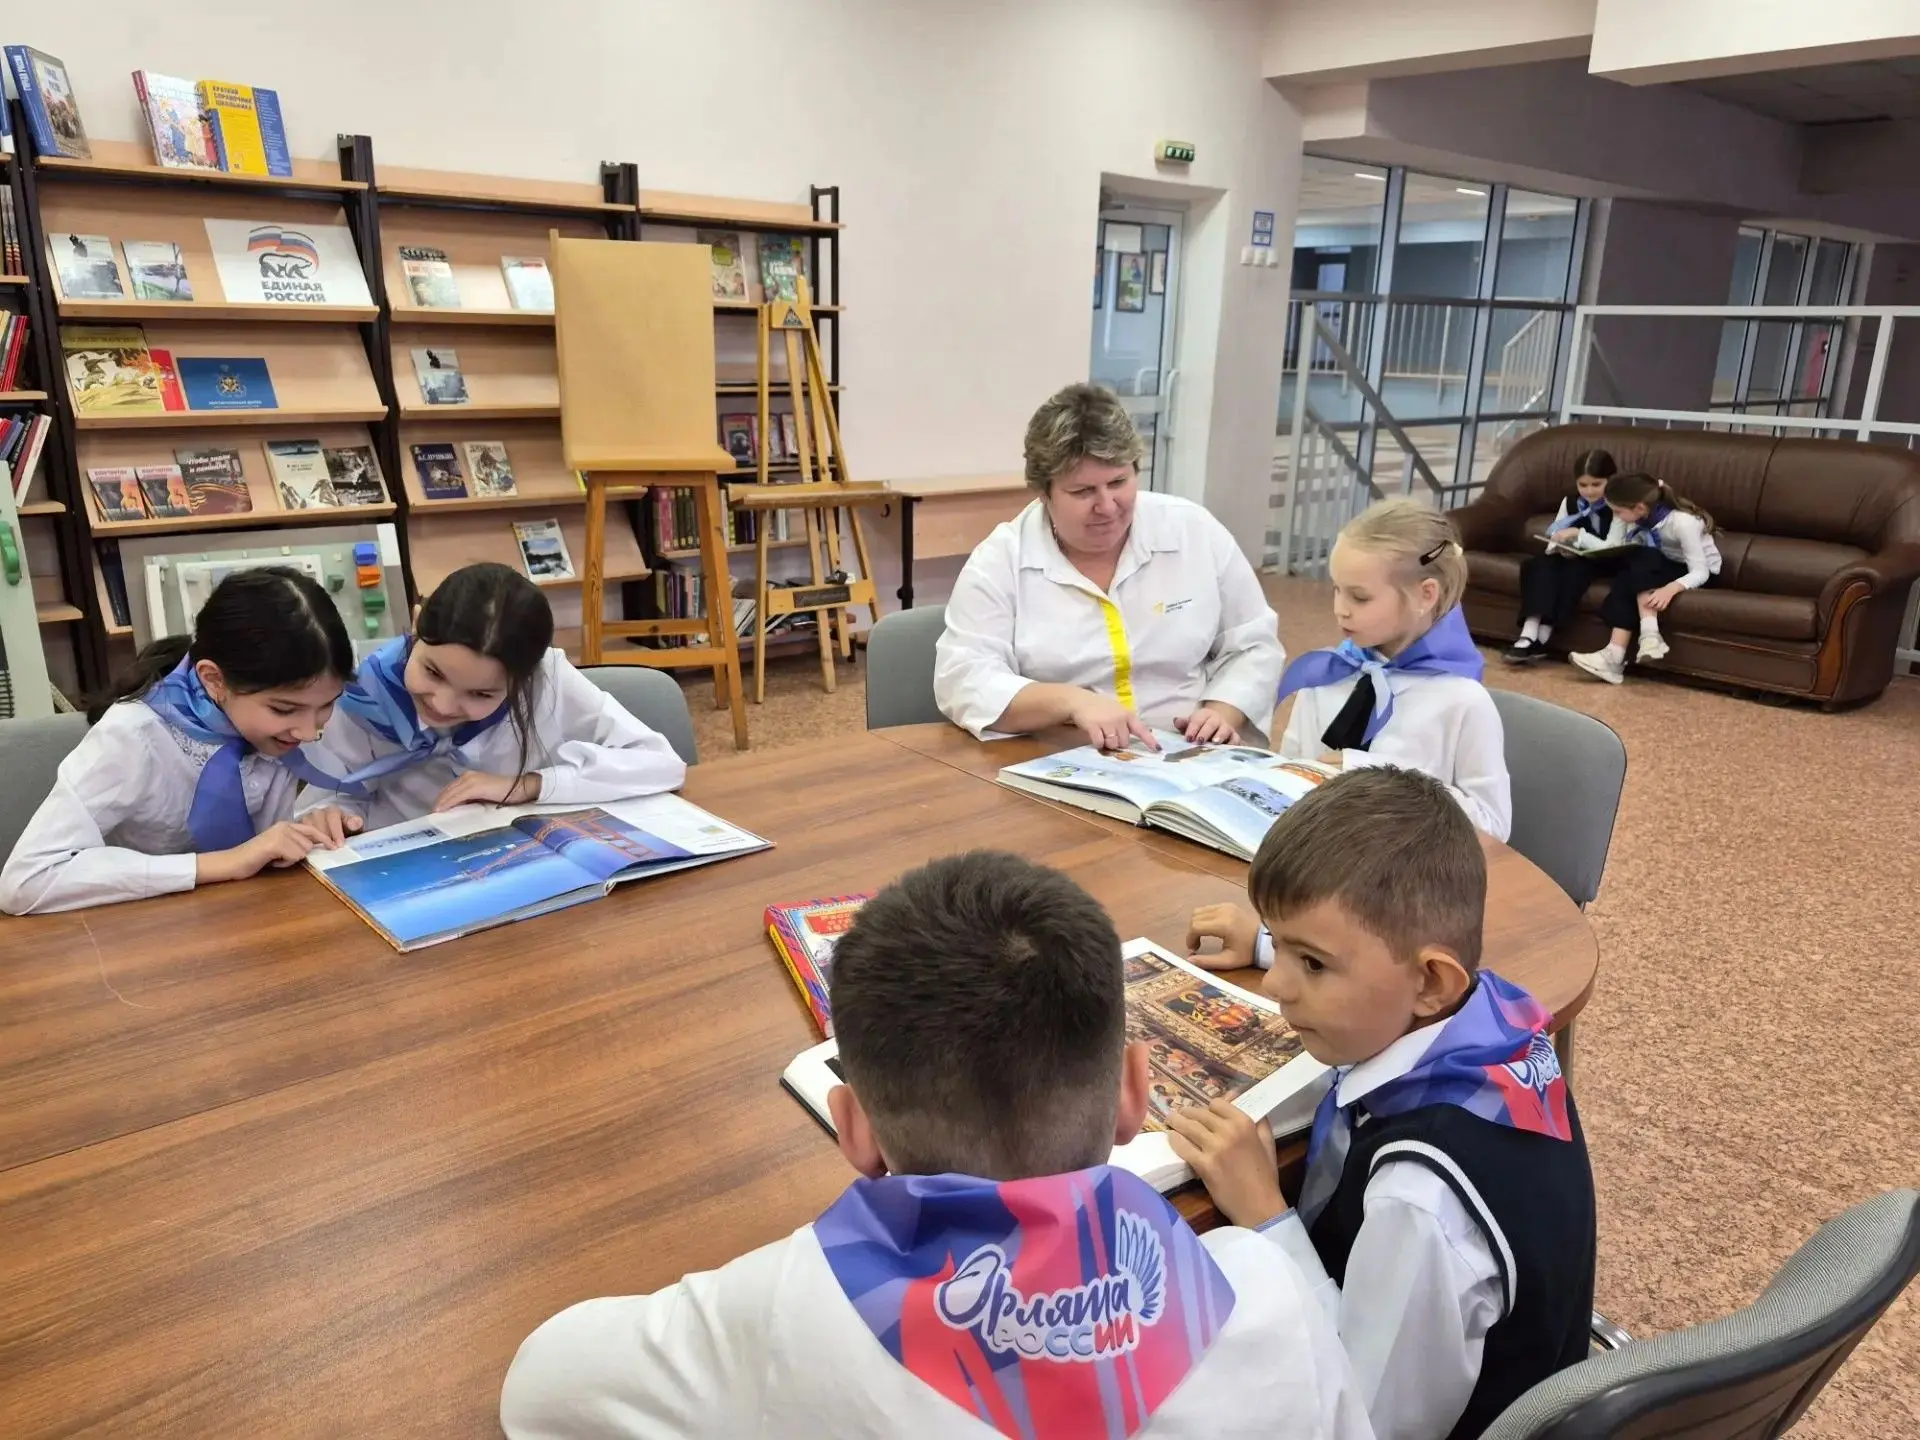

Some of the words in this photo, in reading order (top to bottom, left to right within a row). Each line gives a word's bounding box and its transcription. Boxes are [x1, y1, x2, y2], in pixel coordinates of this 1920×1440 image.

[261, 281, 323, 292] ЕДИНАЯ
[264, 292, 326, 303] РОССИЯ
[939, 1250, 1132, 1336] Орлята
